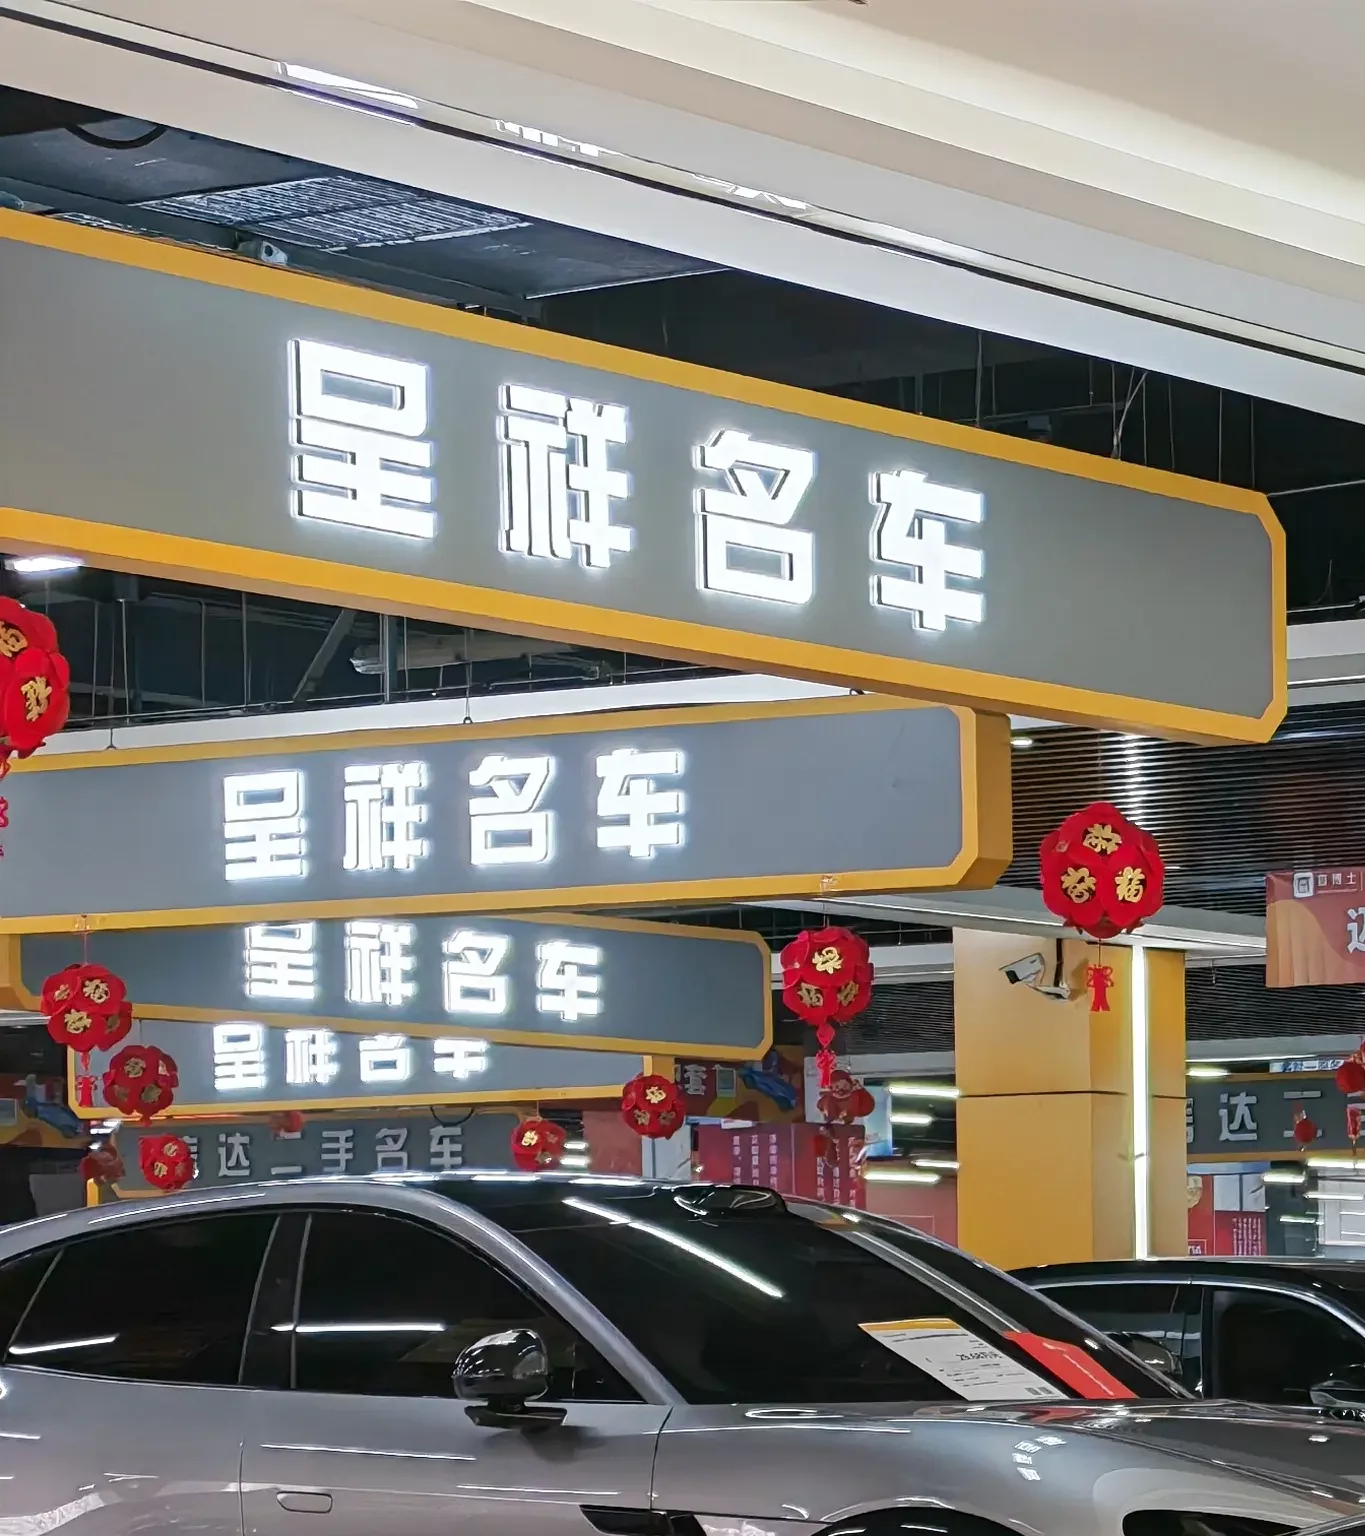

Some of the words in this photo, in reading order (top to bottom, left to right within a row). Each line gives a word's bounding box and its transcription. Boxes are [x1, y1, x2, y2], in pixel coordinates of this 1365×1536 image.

[290, 339, 984, 631] 呈祥名车
[223, 749, 685, 882] 呈祥名车
[245, 921, 602, 1021] 呈祥名车
